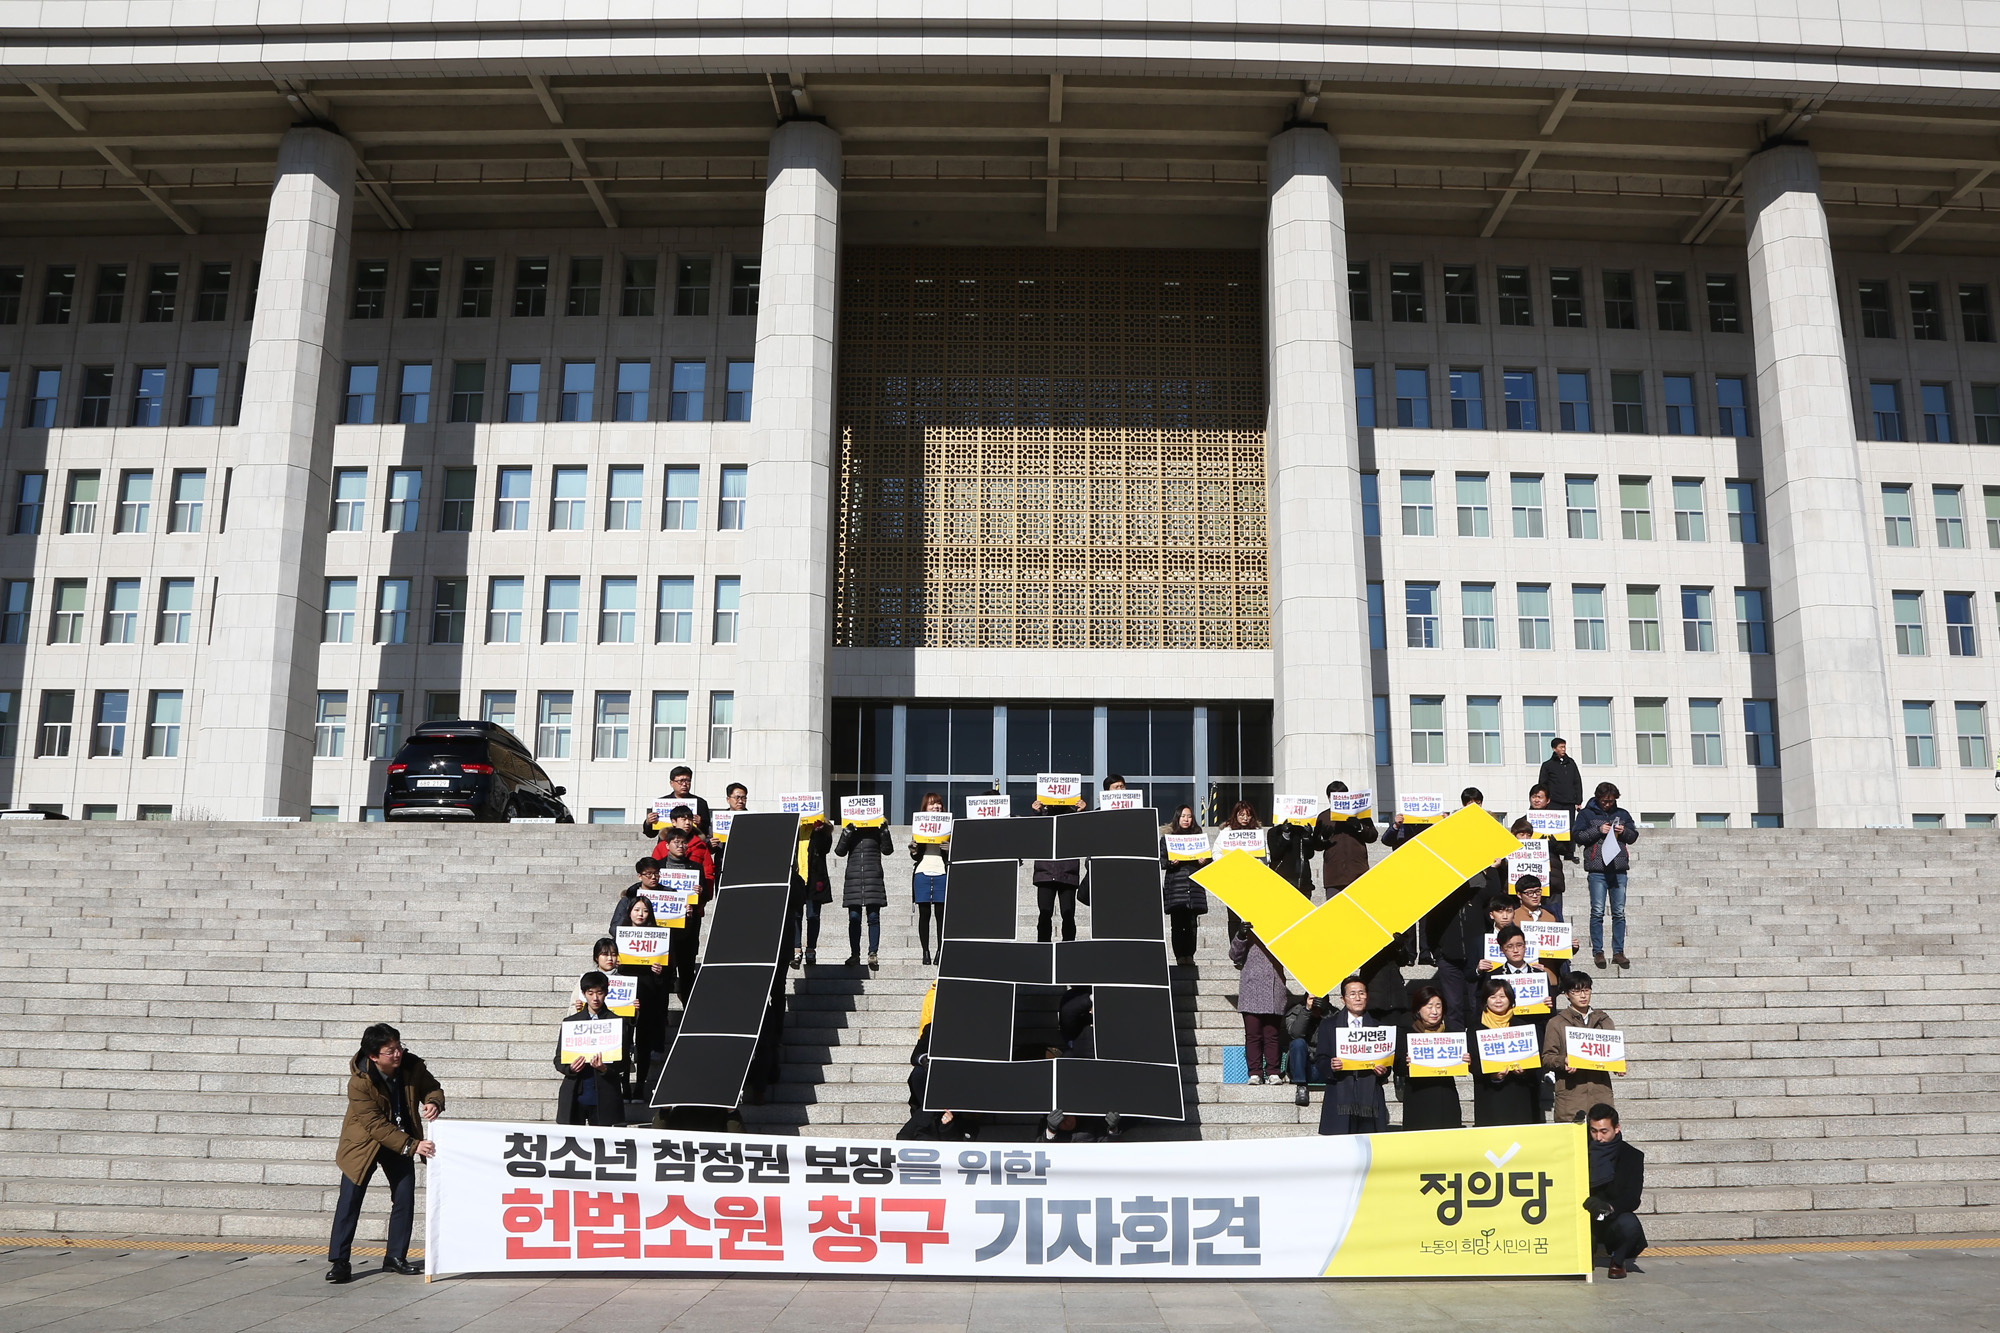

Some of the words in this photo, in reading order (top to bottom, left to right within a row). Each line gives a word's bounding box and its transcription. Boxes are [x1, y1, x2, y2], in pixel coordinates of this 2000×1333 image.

[1047, 784, 1071, 795] 삭제!
[783, 802, 799, 812] 헌법
[801, 801, 820, 812] 소원!
[848, 797, 876, 807] 선거연령
[1111, 800, 1133, 809] 삭제!
[1334, 800, 1350, 810] 헌법
[1352, 798, 1368, 809] 소원!
[1404, 802, 1420, 812] 헌법
[1421, 802, 1440, 812] 소원!
[867, 807, 882, 815] 인하!
[977, 806, 1001, 817] 삭제!
[1284, 805, 1307, 815] 삭제!
[919, 822, 942, 833] 삭제!
[1530, 819, 1545, 829] 헌법
[1548, 820, 1566, 829] 소원!
[1228, 831, 1256, 840] 선거연령
[1169, 841, 1185, 850] 헌법
[1188, 841, 1205, 850] 소원!
[1516, 863, 1542, 873] 선거연령
[673, 880, 696, 891] 소원!
[660, 902, 682, 914] 소원!
[618, 930, 643, 938] 정당가입
[644, 931, 668, 939] 연령제한
[1523, 925, 1546, 933] 정당가입
[1547, 926, 1569, 934] 연령제한
[628, 939, 657, 953] 삭제!
[607, 988, 632, 1001] 소원!
[1519, 985, 1544, 999] 소원!
[573, 1022, 612, 1035] 선거연령
[565, 1036, 598, 1047] 만18세로
[599, 1034, 619, 1046] 인하!
[1348, 1030, 1387, 1042] 선거연령
[1433, 1037, 1455, 1045] 참정권을
[1480, 1033, 1502, 1042] 청소년의
[1502, 1031, 1524, 1040] 평등권을
[1569, 1030, 1594, 1040] 정당가입
[1595, 1033, 1621, 1043] 연령제한
[1340, 1043, 1373, 1055] 만18세로
[1374, 1042, 1394, 1053] 인하!
[1483, 1041, 1505, 1056] 헌법
[1508, 1038, 1533, 1053] 소원!
[1580, 1041, 1611, 1057] 삭제!
[1413, 1046, 1434, 1060] 헌법
[1437, 1046, 1462, 1059] 소원!
[503, 1132, 637, 1181] 청소년
[652, 1138, 790, 1183] 참정권
[805, 1145, 941, 1185] 보장을
[958, 1149, 1051, 1185] 위한
[1419, 1171, 1553, 1225] 정의당
[502, 1188, 784, 1261] 헌법소원
[808, 1195, 949, 1264] 청구
[975, 1196, 1261, 1266] 기자회견
[1420, 1240, 1457, 1255] 노동의
[1461, 1236, 1490, 1255] 희망
[1495, 1239, 1531, 1254] 시민의
[1533, 1237, 1549, 1254] 꿈
